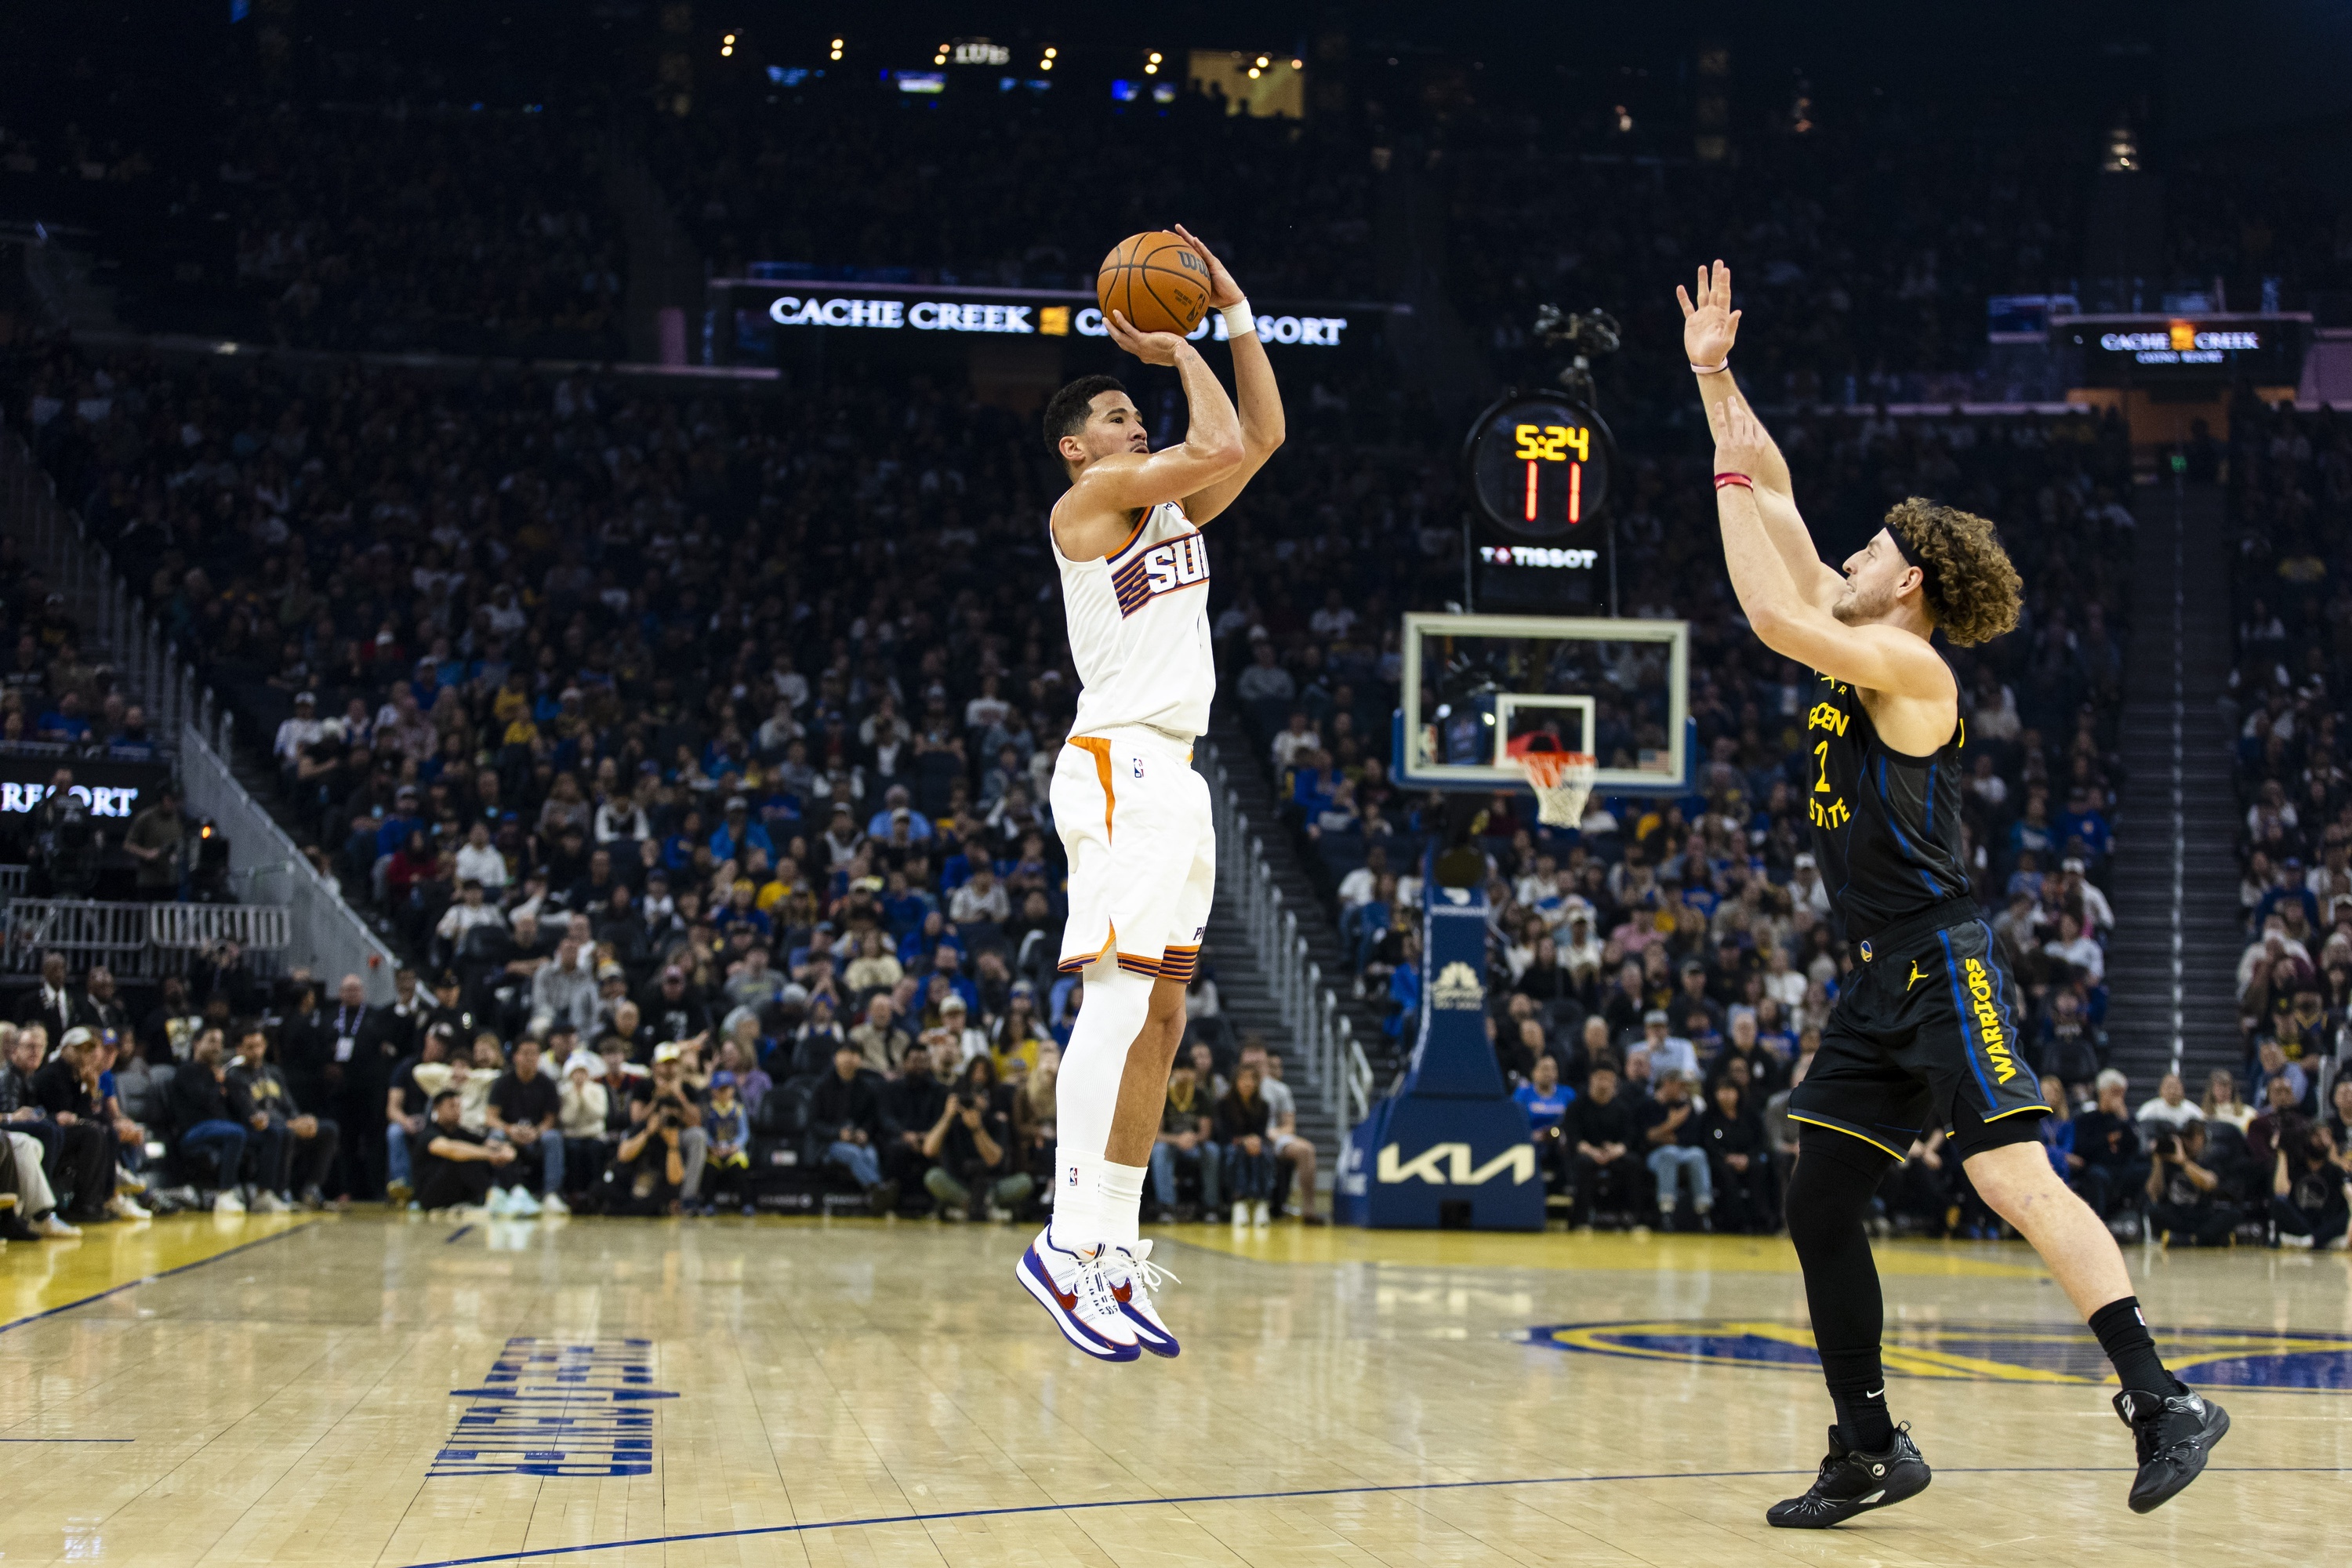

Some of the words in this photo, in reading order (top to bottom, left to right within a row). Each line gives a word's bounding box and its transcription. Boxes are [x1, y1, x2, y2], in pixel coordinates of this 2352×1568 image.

[770, 296, 904, 328] CACHE
[909, 302, 1034, 333] CREEK
[1515, 424, 1589, 462] 5:24
[1525, 459, 1581, 524] 11
[1511, 546, 1598, 569] TISSOT
[1814, 740, 1831, 793] 2
[1965, 958, 2016, 1085] WARRIORS
[1377, 1142, 1535, 1185] KIA
